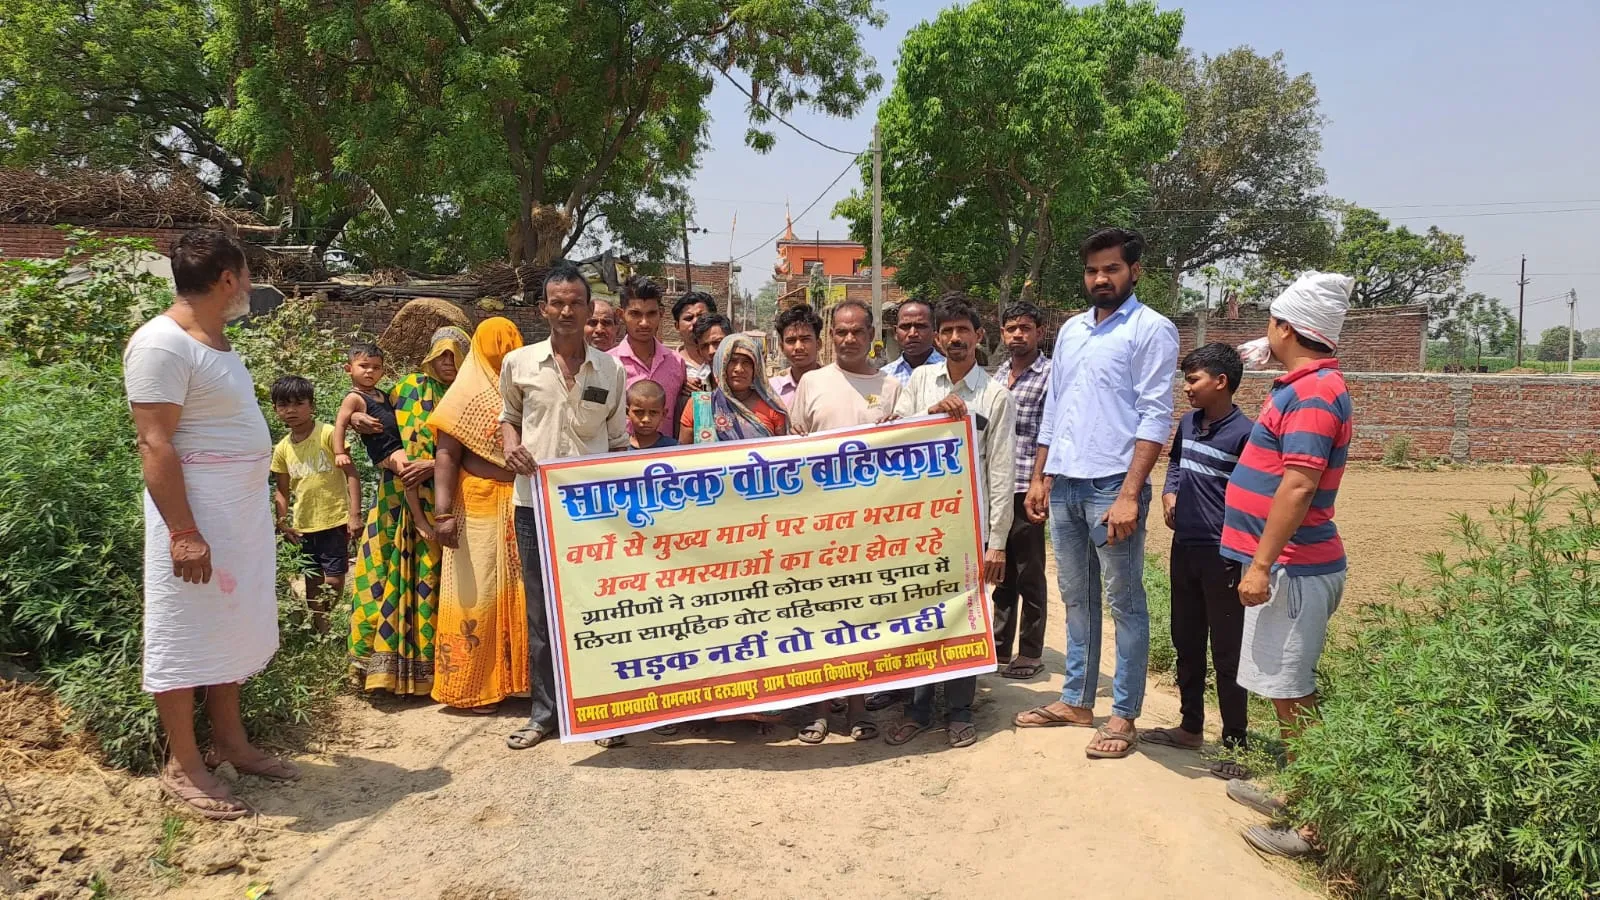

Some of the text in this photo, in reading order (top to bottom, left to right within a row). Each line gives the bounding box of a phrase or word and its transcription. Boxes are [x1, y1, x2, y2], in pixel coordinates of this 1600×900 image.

[558, 438, 963, 528] सामूहिक वोट बहिष्कार
[566, 489, 964, 563] वर्षों से मुख्य मार्ग पर जल भराव एवं
[594, 527, 945, 597] अन्य समस्याओं का दंश झेल रहे
[573, 580, 960, 651] लिया सामूहिक वोट बहिष्कार का निर्णय
[581, 556, 950, 625] ग्रामीणों ने आगामी लोक सभा चुनाव में
[611, 602, 946, 681] सड़क नहीं तो वोट नहीं
[575, 703, 609, 722] समस्त
[611, 692, 659, 718] ग्रामवासी
[660, 687, 702, 709] रामनगर
[702, 686, 712, 701] व
[762, 674, 785, 693] ग्राम
[787, 668, 822, 688] पंचायत
[940, 638, 989, 665] (कासगंज)
